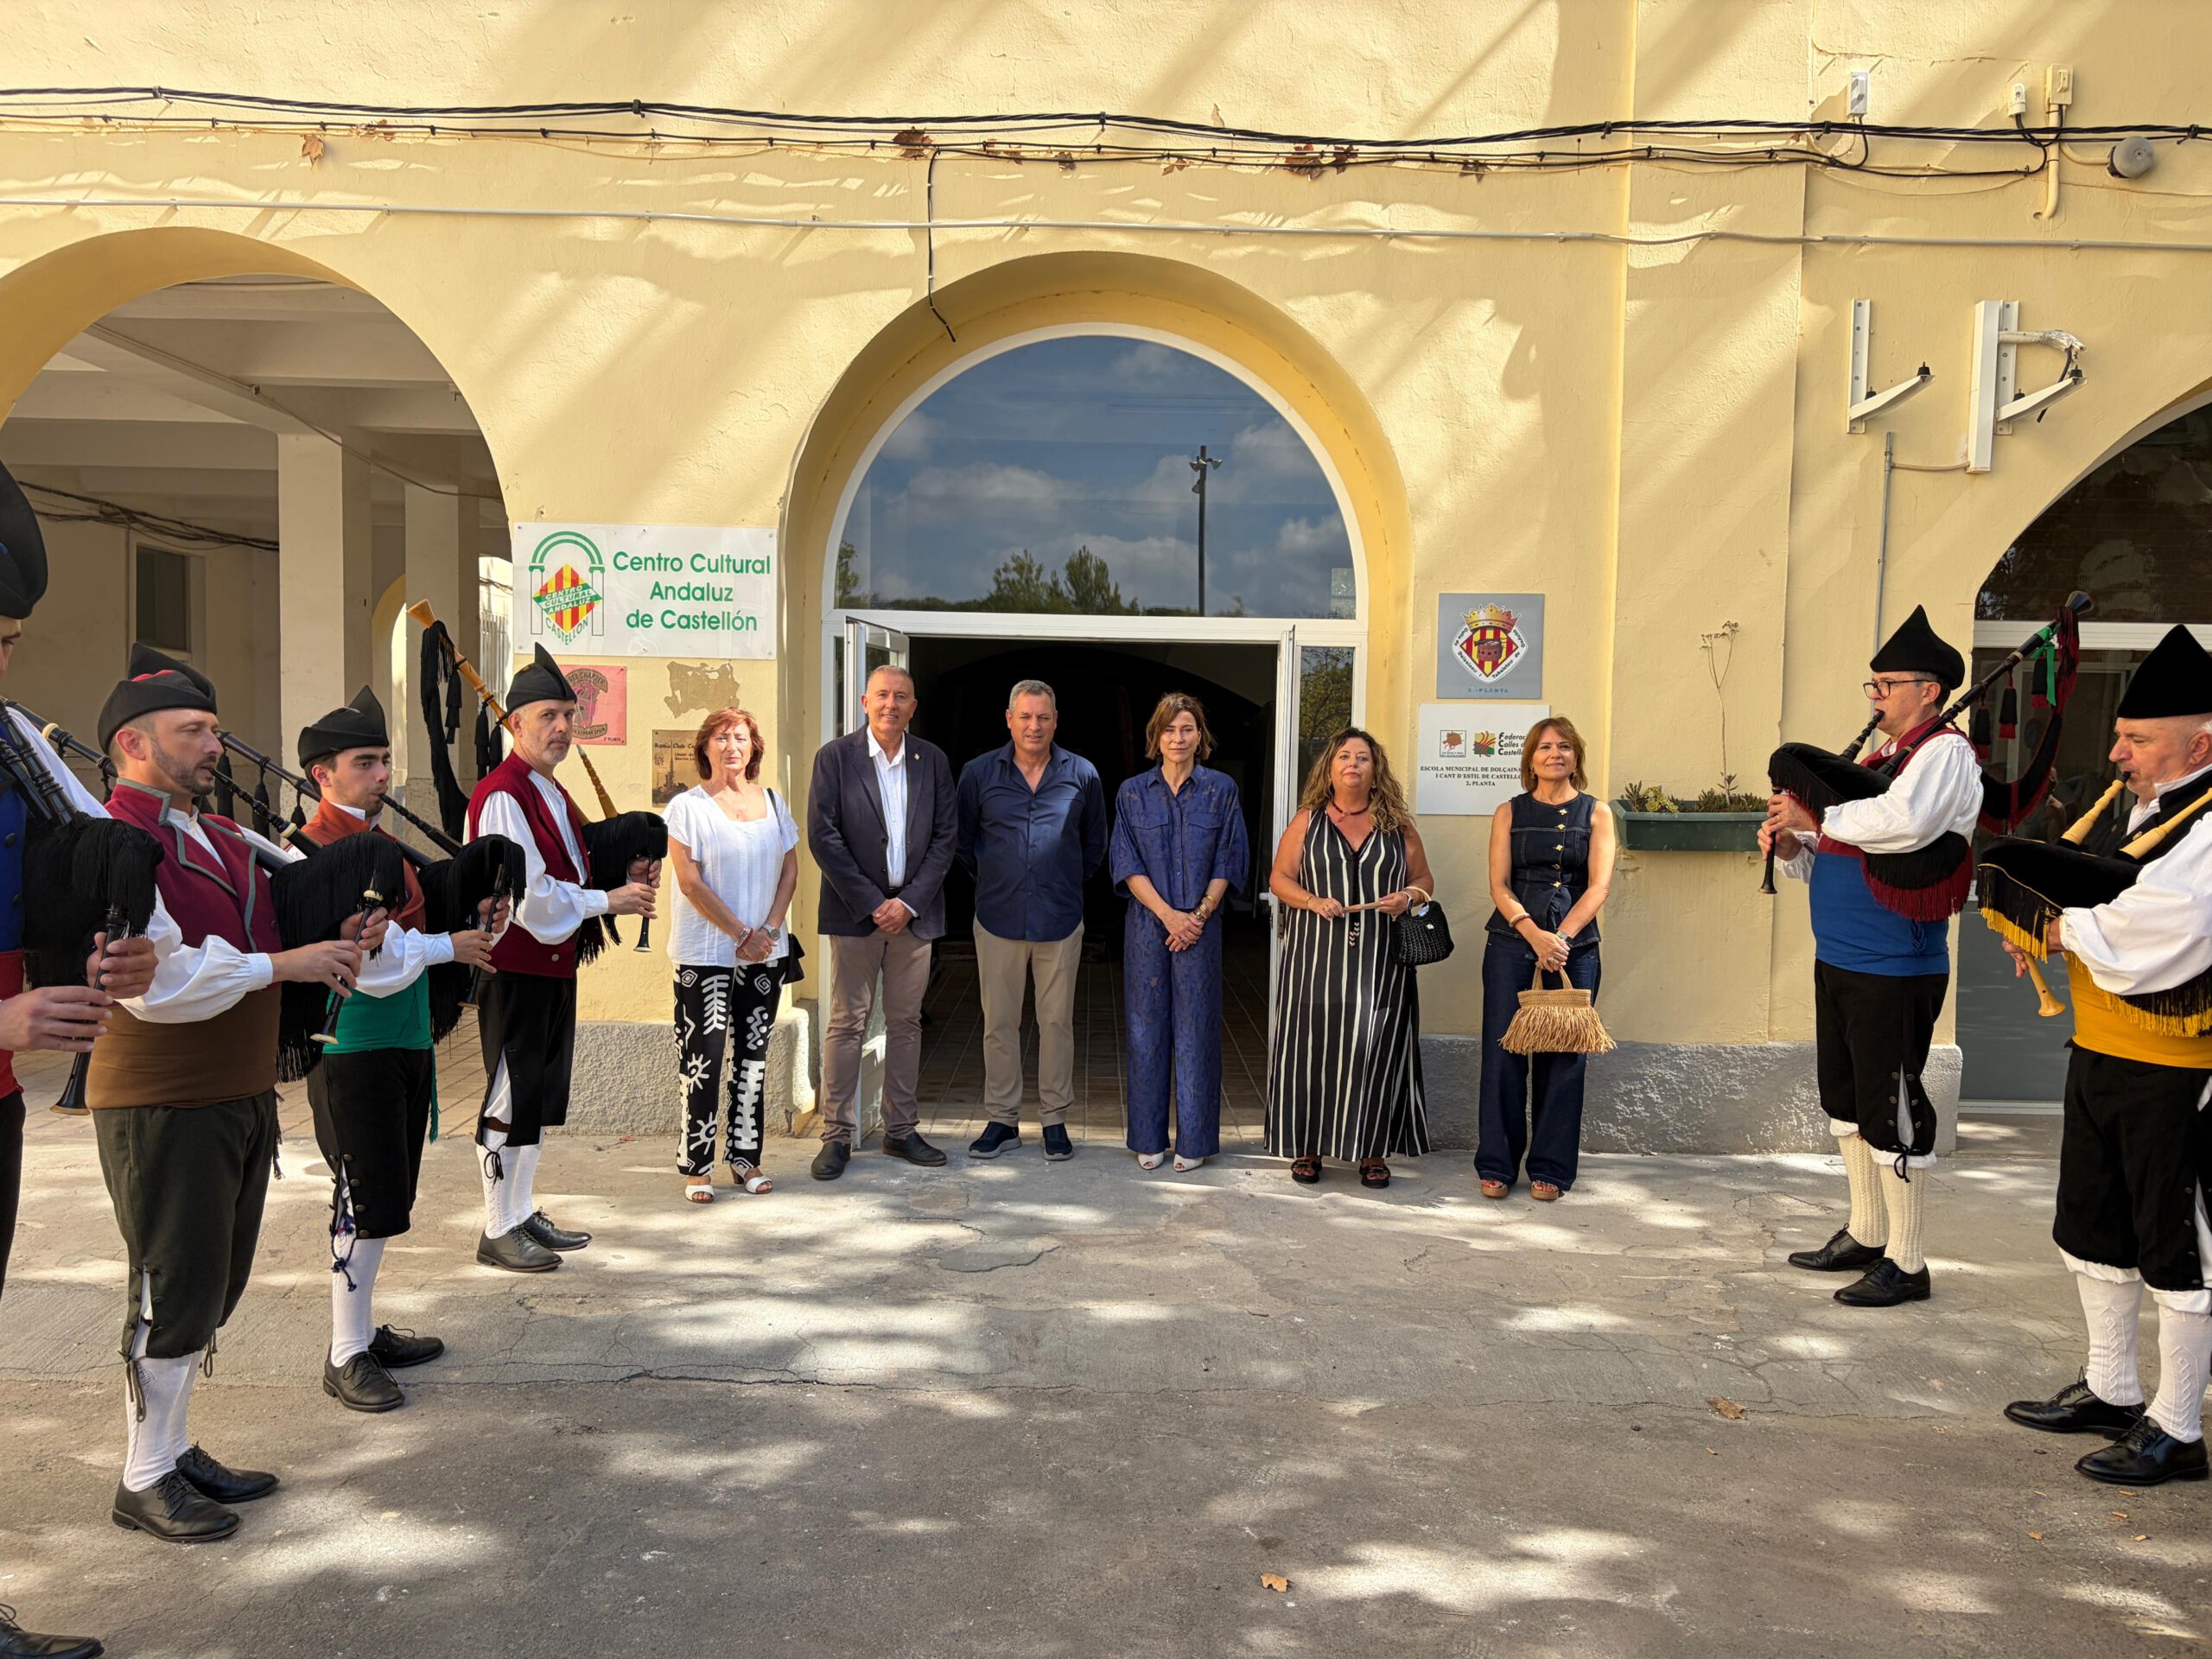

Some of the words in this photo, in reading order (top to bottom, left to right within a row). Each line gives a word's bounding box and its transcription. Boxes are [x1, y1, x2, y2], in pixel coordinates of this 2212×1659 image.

[613, 550, 683, 572] Centro
[690, 553, 771, 575] Cultural
[544, 589, 592, 607] CULTURAL
[545, 585, 583, 600] CENTRO
[649, 581, 734, 602] Andaluz
[547, 596, 593, 614] ANDALUZ
[626, 608, 654, 629] de
[660, 608, 758, 632] Castellón
